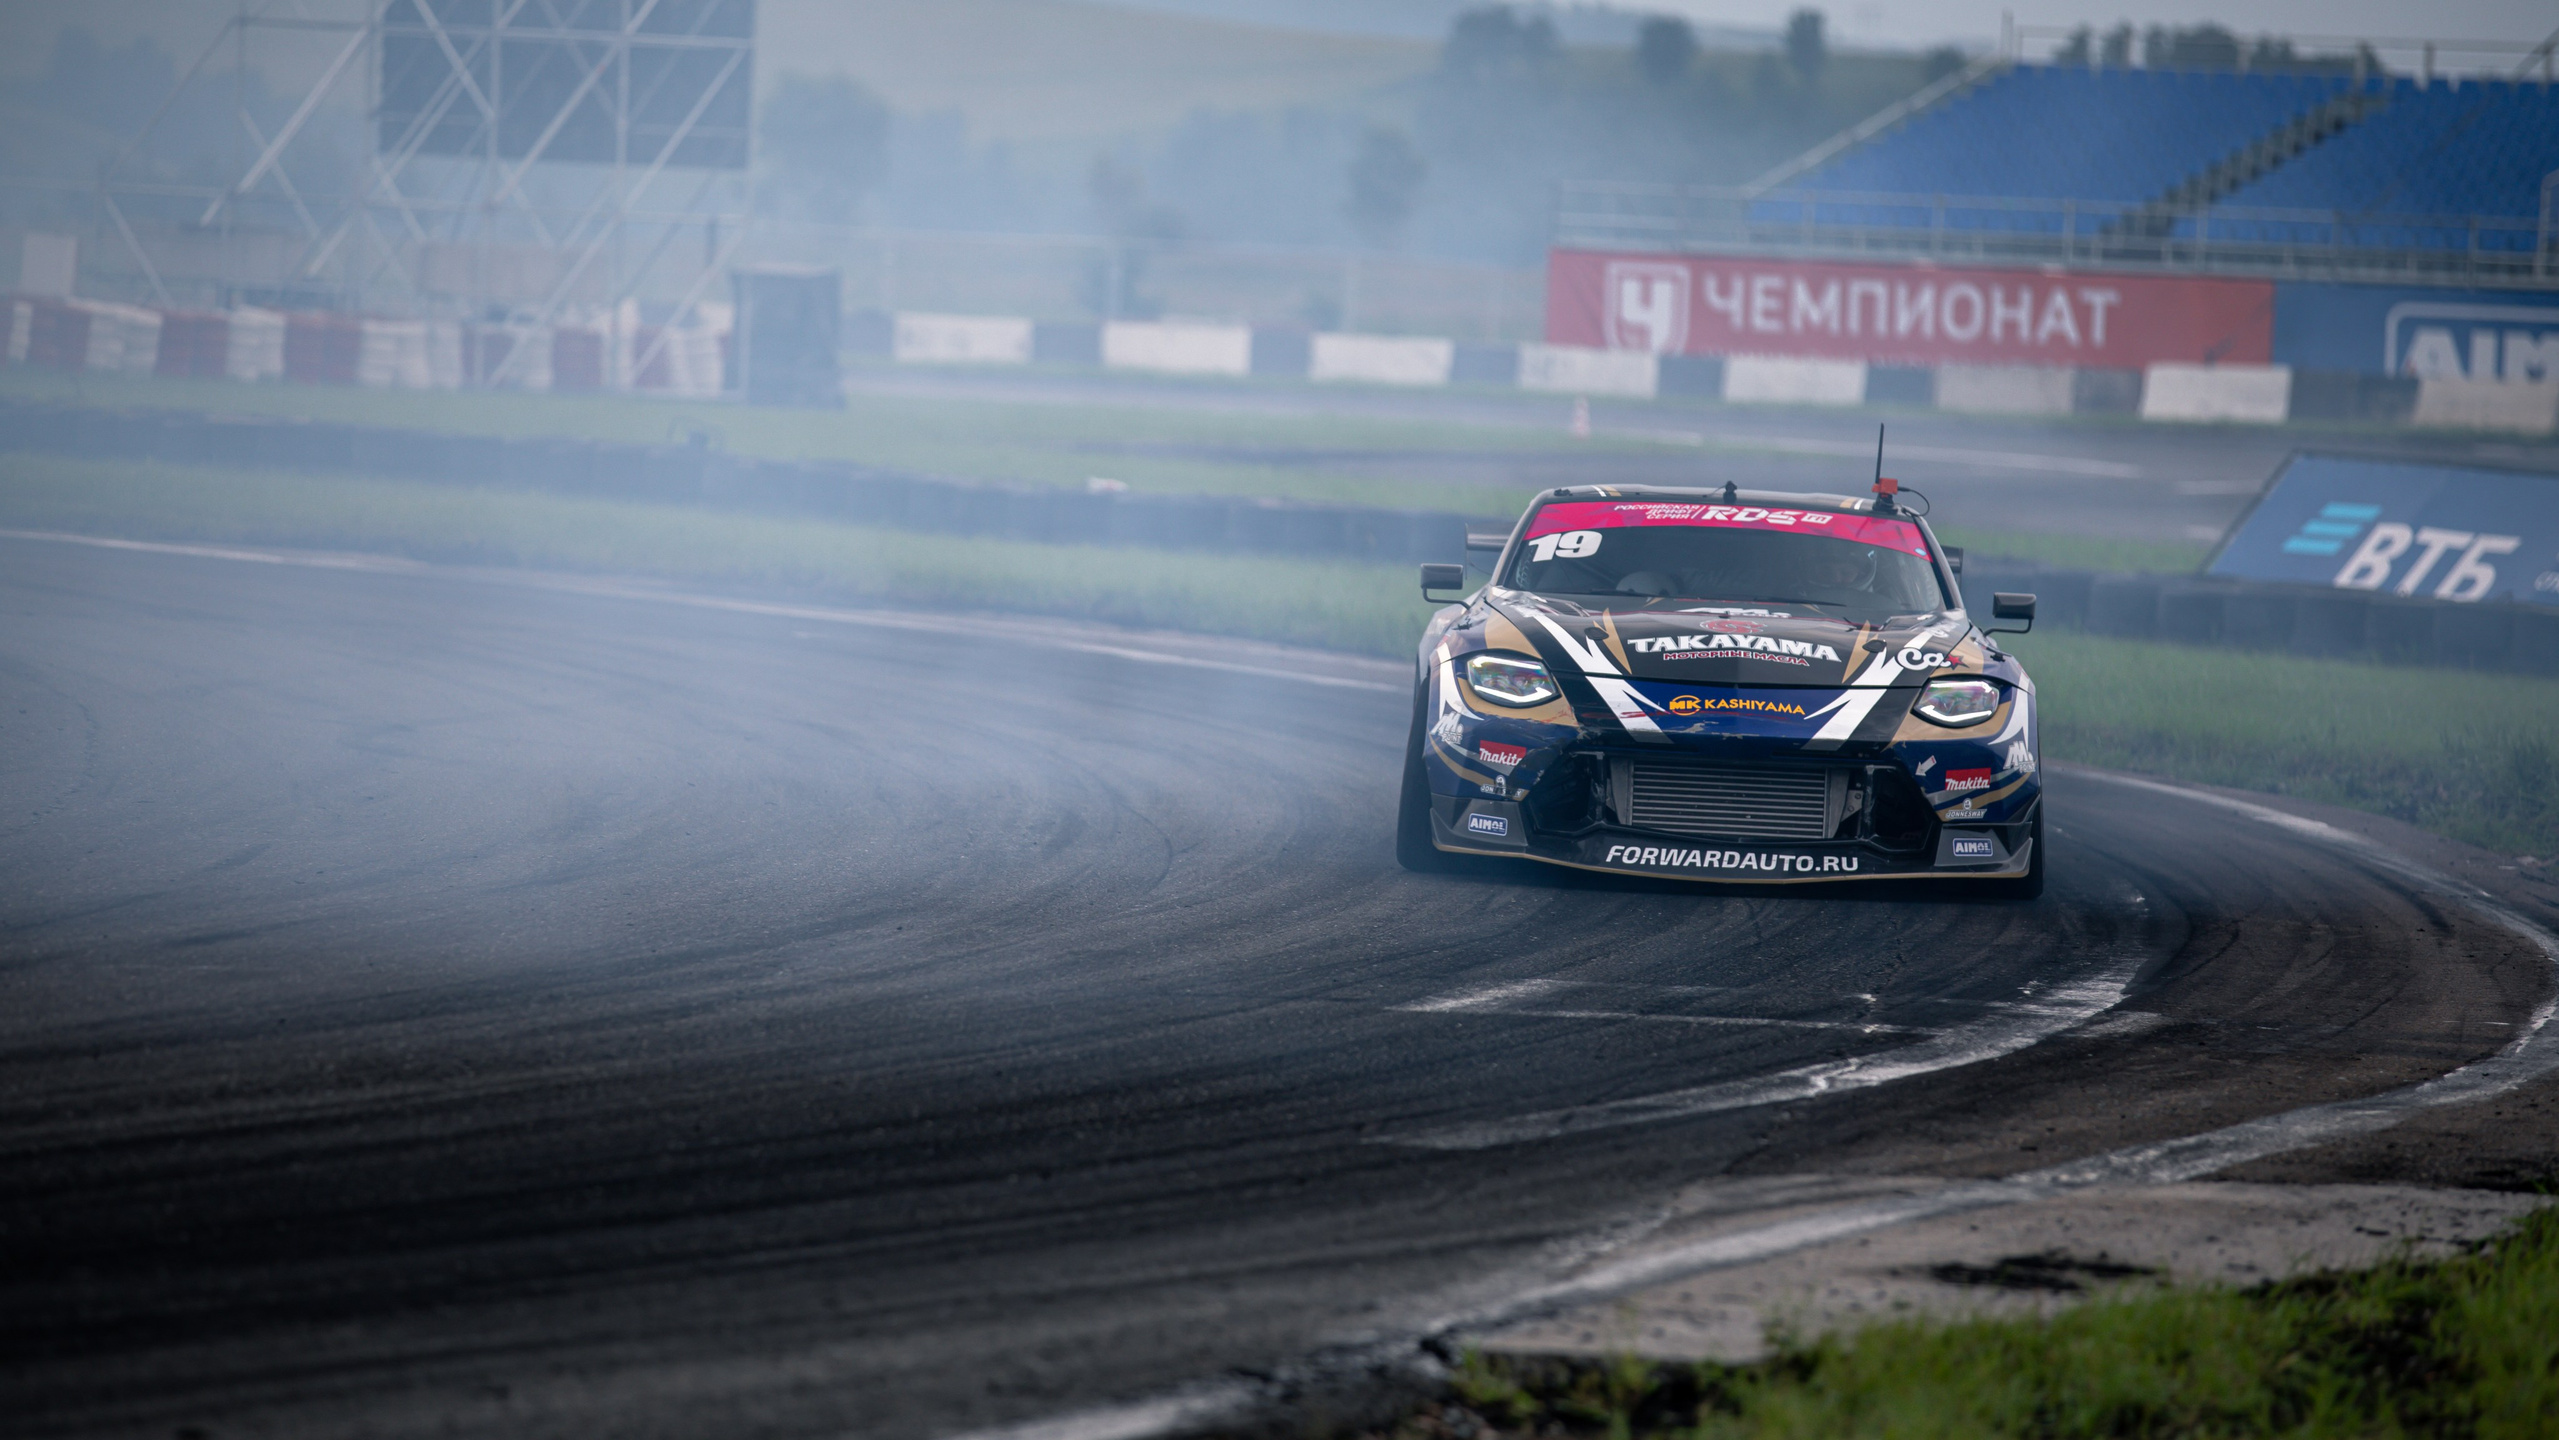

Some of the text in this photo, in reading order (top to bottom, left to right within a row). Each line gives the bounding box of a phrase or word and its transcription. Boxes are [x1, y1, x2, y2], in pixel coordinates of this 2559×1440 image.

[1703, 271, 2120, 346] ЧЕМПИОНАТ
[1613, 503, 1701, 511] РОССИЙСКАЯ
[1701, 505, 1805, 526] RDS
[1529, 530, 1603, 563] 19
[2332, 521, 2522, 602] ВТБ
[1627, 633, 1842, 663] TAKAYAMA
[1663, 650, 1810, 667] МОТОРНЫЕ МАСЛА
[1704, 698, 1806, 716] KASHIYAMA
[1945, 776, 1991, 791] Makita
[1946, 809, 1986, 819] JONNESWAY
[1955, 842, 1991, 853] AIMOL
[1606, 845, 1859, 872] FORWARDAUTO.RU
